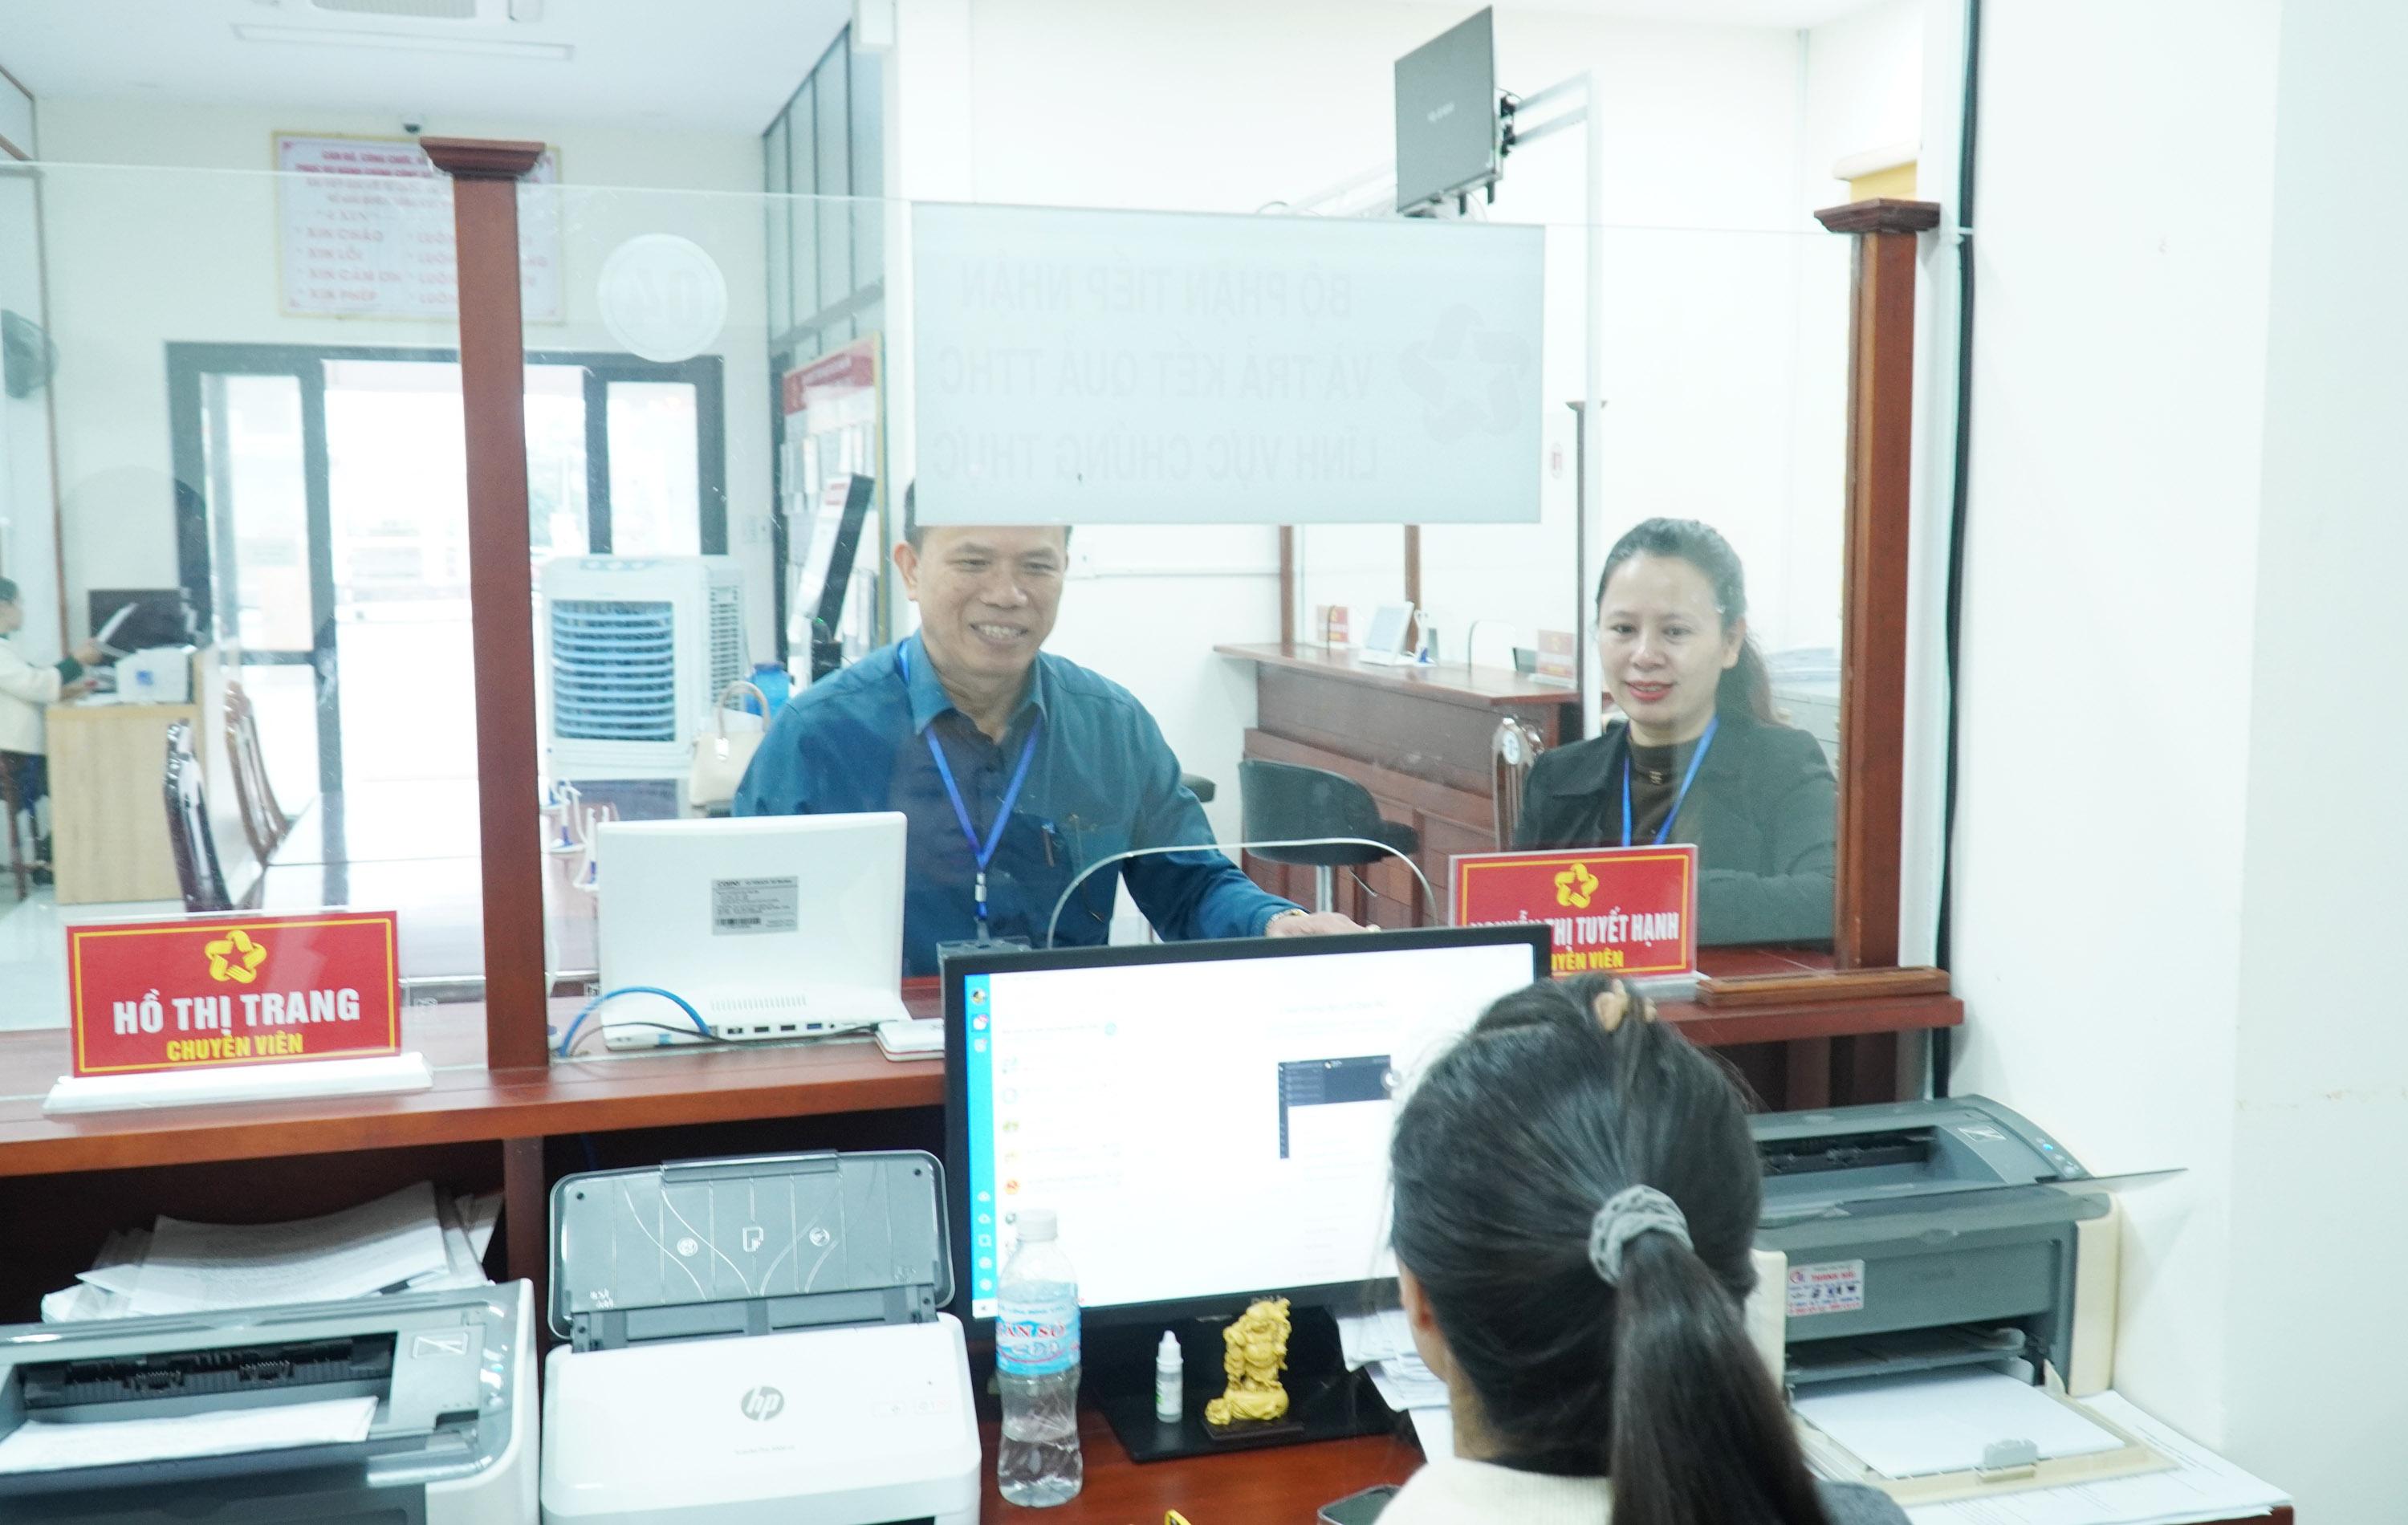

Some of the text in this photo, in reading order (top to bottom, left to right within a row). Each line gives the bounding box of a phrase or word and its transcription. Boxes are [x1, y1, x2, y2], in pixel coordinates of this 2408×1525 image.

[1576, 906, 1629, 946] TUYẾT
[1630, 912, 1679, 947] HẠNH
[1588, 947, 1625, 969] VIÊN
[113, 987, 360, 1036] HỒ THỊ TRANG
[166, 1030, 303, 1062] CHUYÊN VIÊN
[746, 1386, 780, 1421] hp
